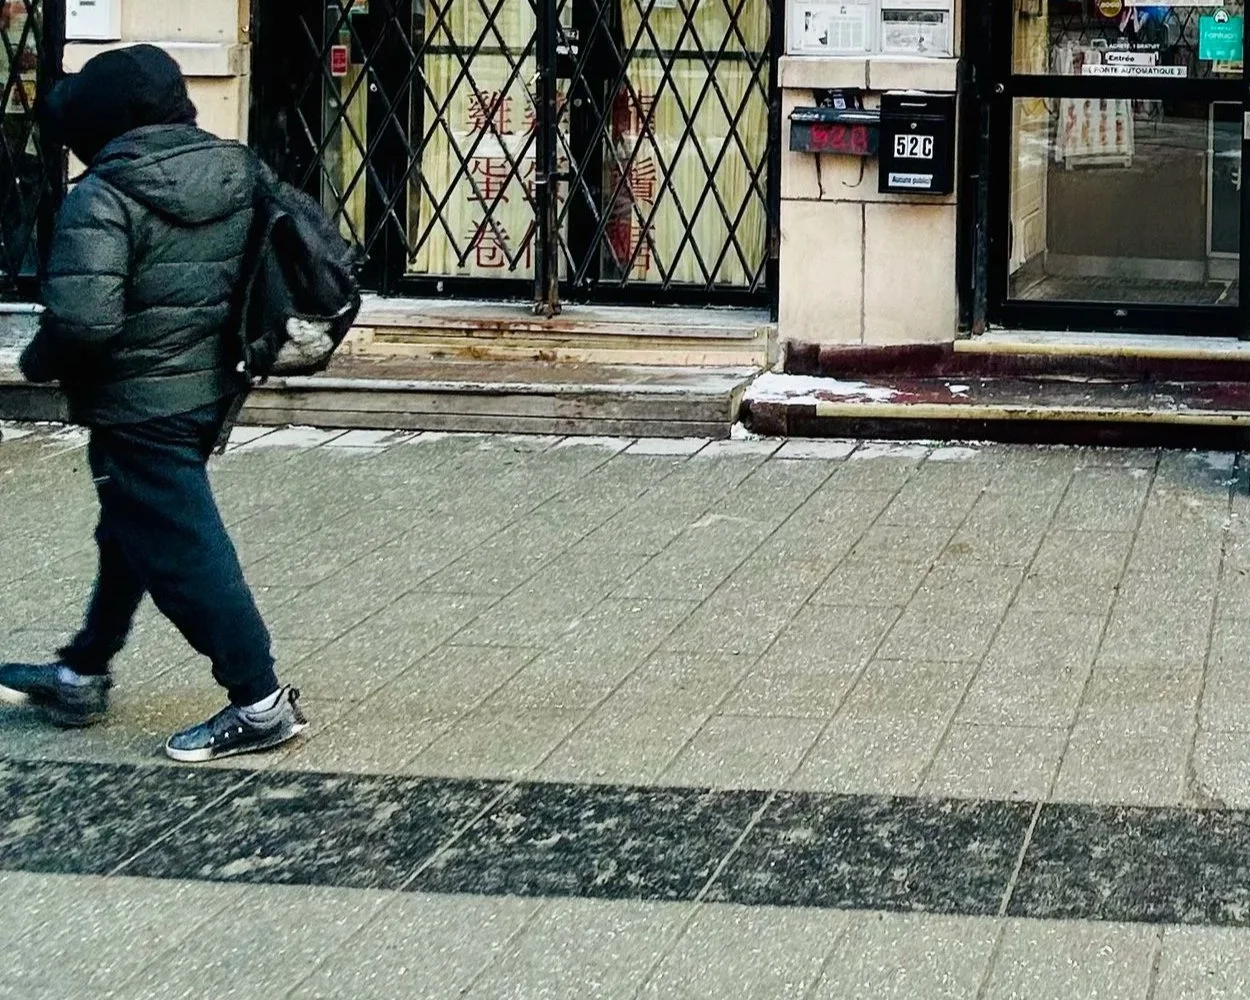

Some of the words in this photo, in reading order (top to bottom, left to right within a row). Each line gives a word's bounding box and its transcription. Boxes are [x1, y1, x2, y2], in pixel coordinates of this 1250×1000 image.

[1108, 53, 1135, 62] Entrée
[1121, 66, 1175, 76] AUTOMATIQUE
[896, 136, 932, 157] 52C
